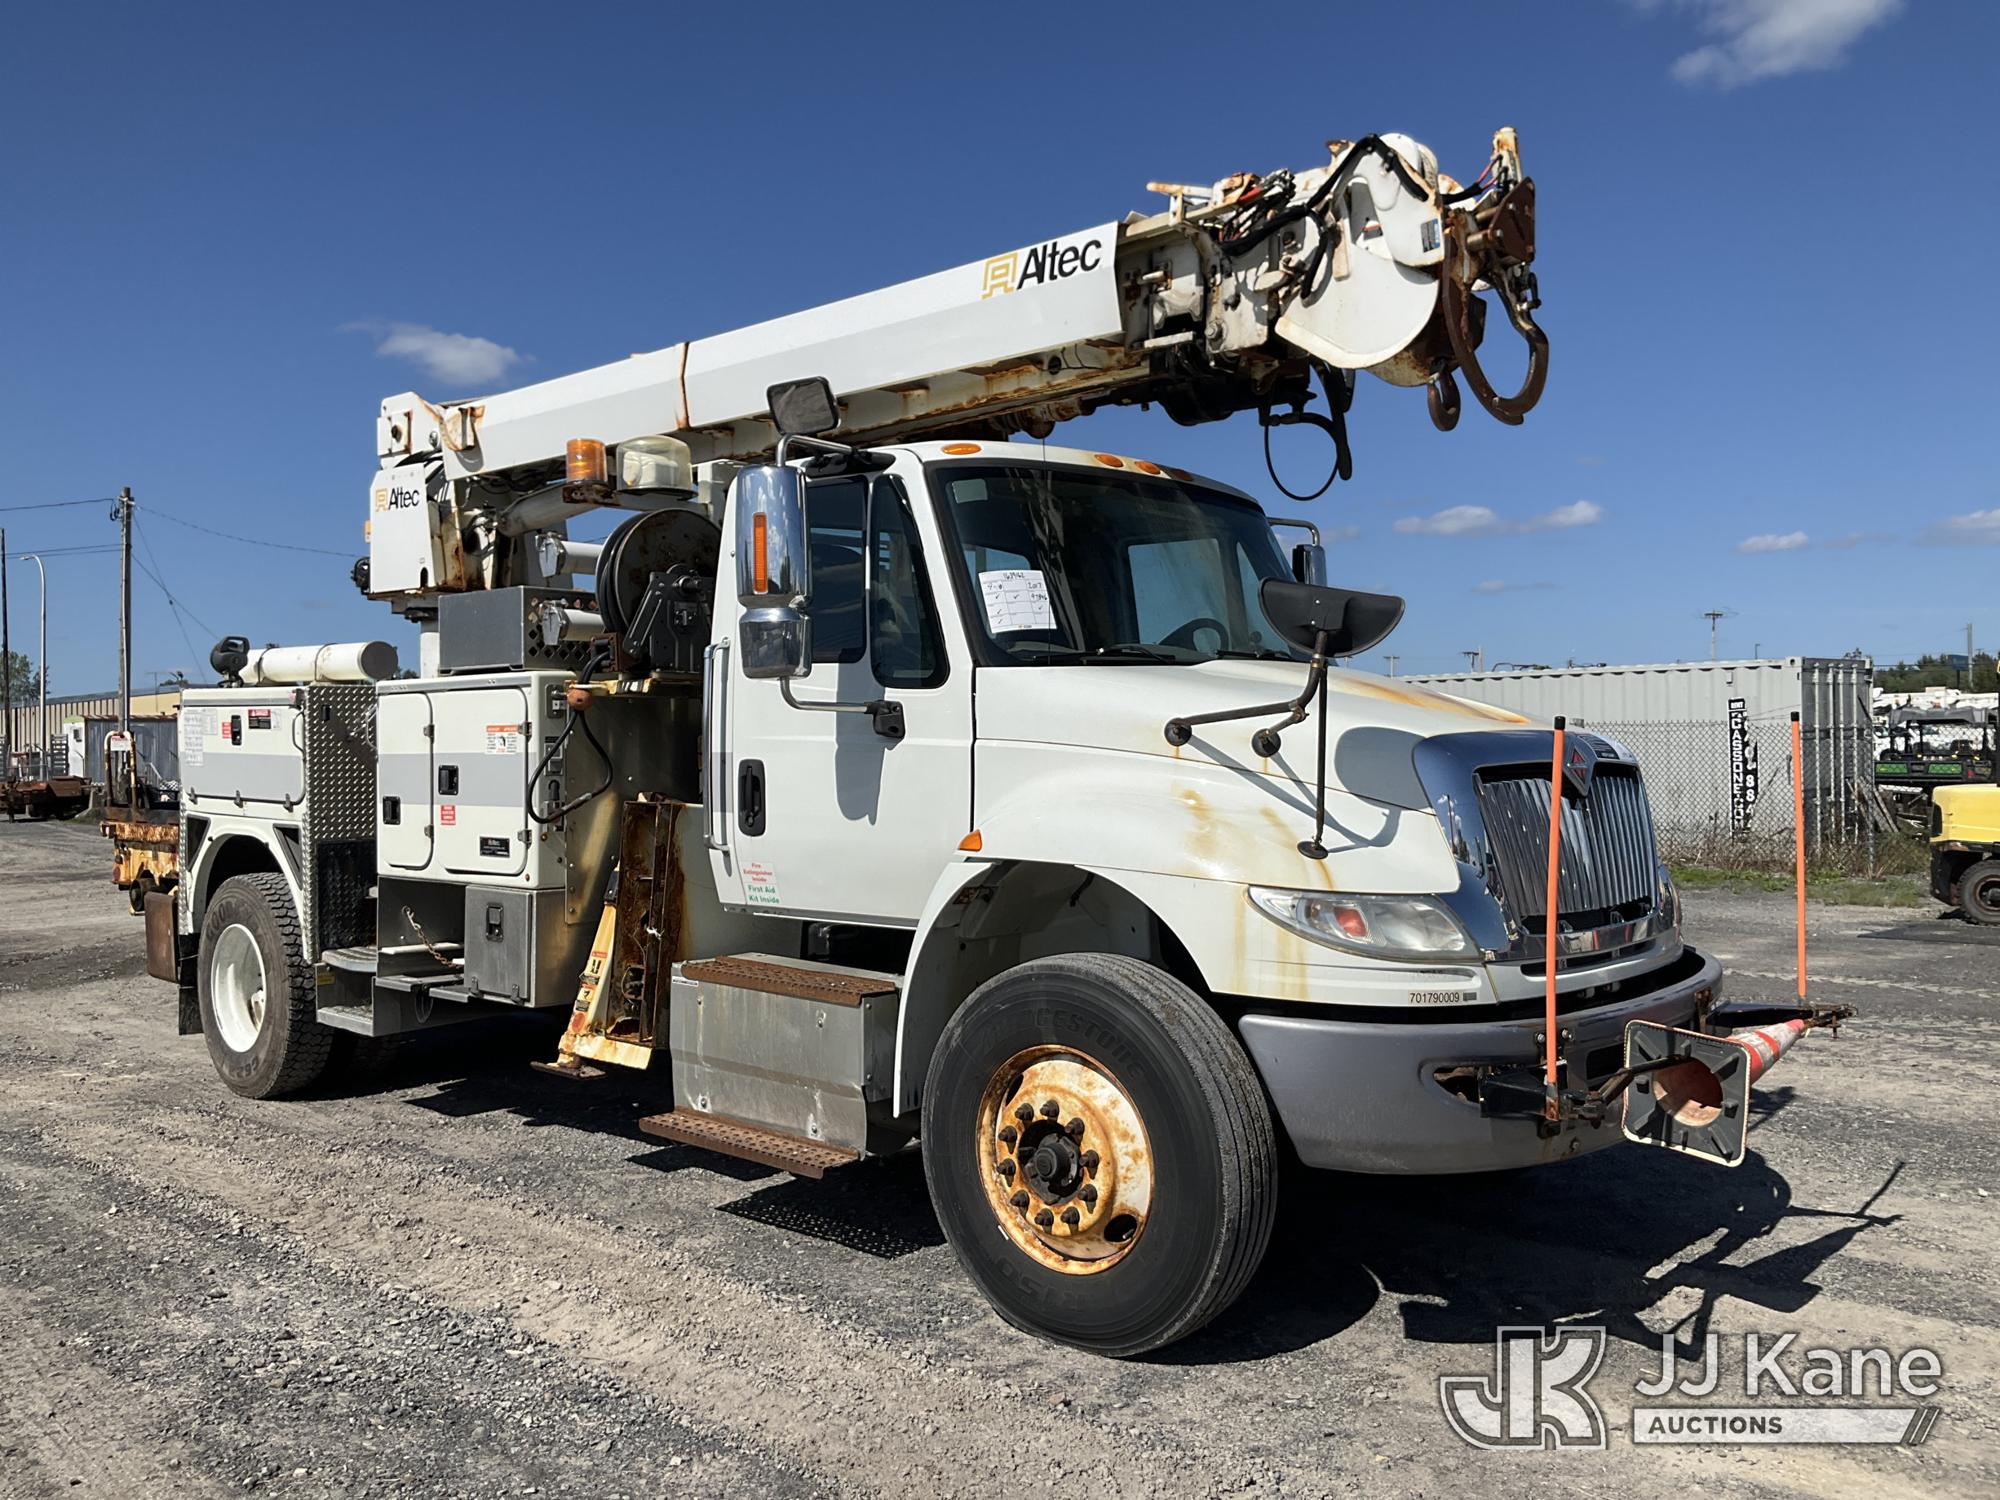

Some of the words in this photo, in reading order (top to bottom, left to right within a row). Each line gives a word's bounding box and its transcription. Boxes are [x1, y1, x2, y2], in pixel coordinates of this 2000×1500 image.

[1017, 240, 1102, 290] Altec
[388, 487, 420, 510] Altec
[748, 885, 763, 893] First
[765, 885, 776, 894] Aid
[749, 894, 759, 902] Kit
[760, 896, 780, 904] Inside
[1409, 992, 1460, 1003] 701790009
